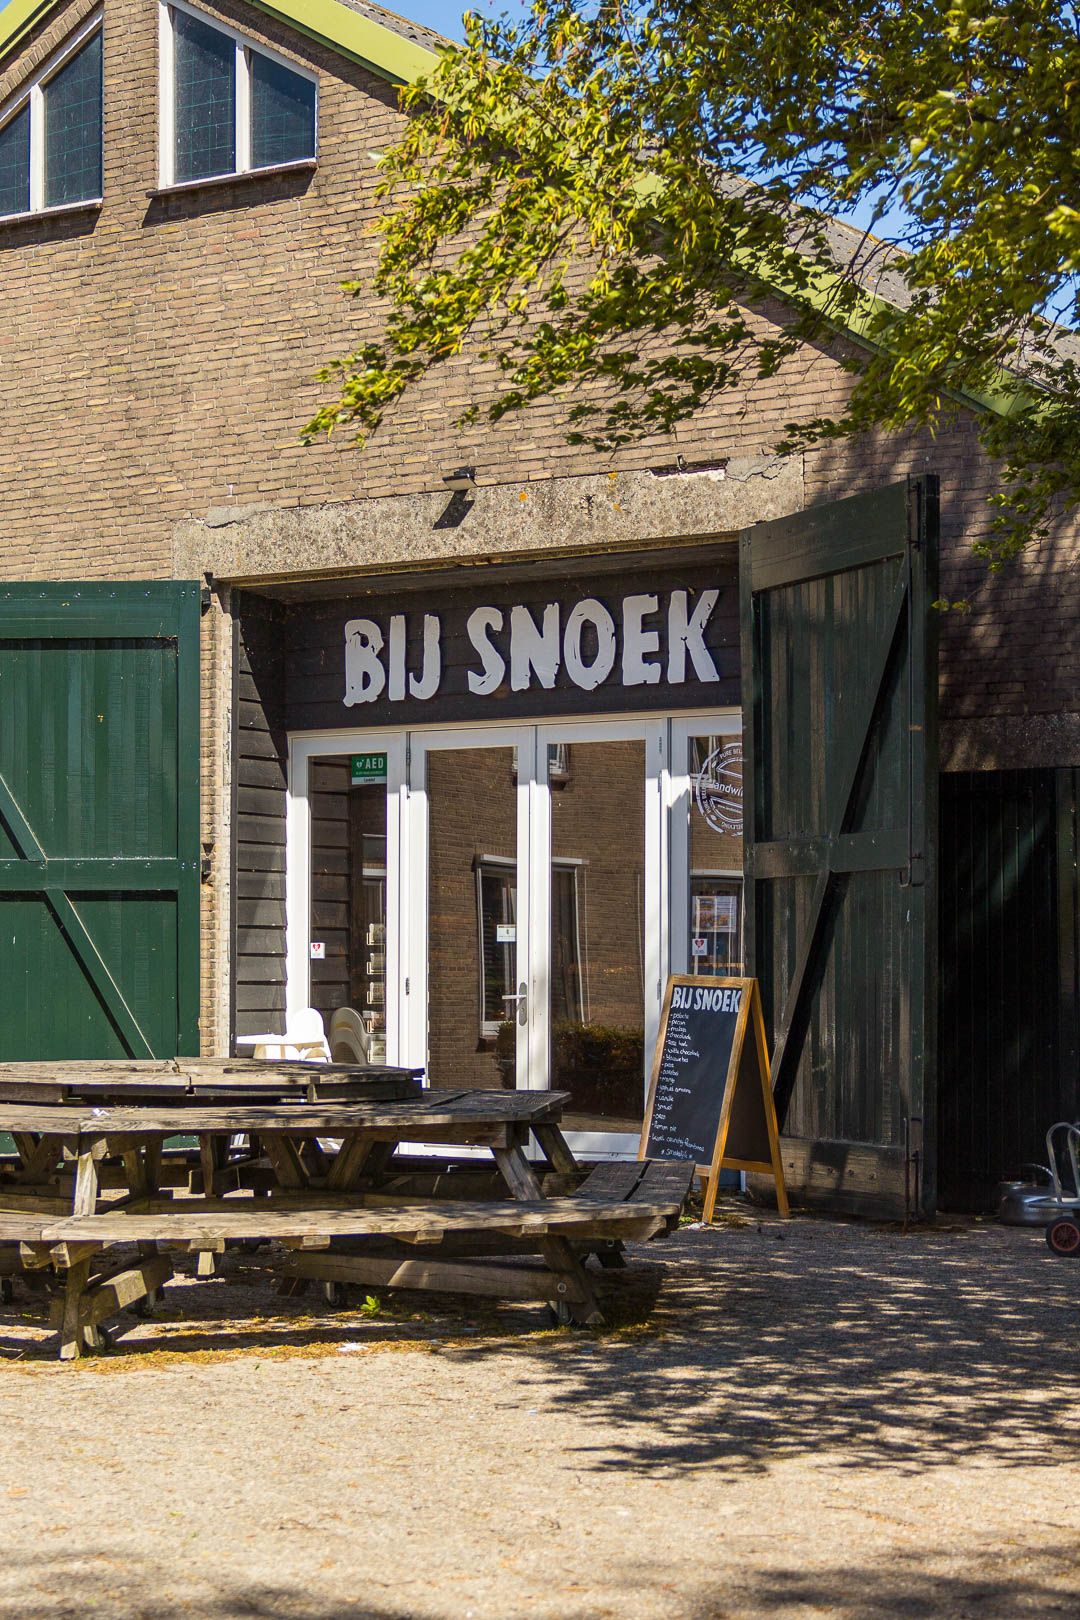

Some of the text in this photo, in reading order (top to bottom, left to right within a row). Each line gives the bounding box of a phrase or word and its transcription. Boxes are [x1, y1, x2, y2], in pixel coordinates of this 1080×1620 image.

[343, 589, 720, 707] BIJ SNOEK
[365, 757, 384, 769] AED
[671, 987, 742, 1013] BIJ SNOEK
